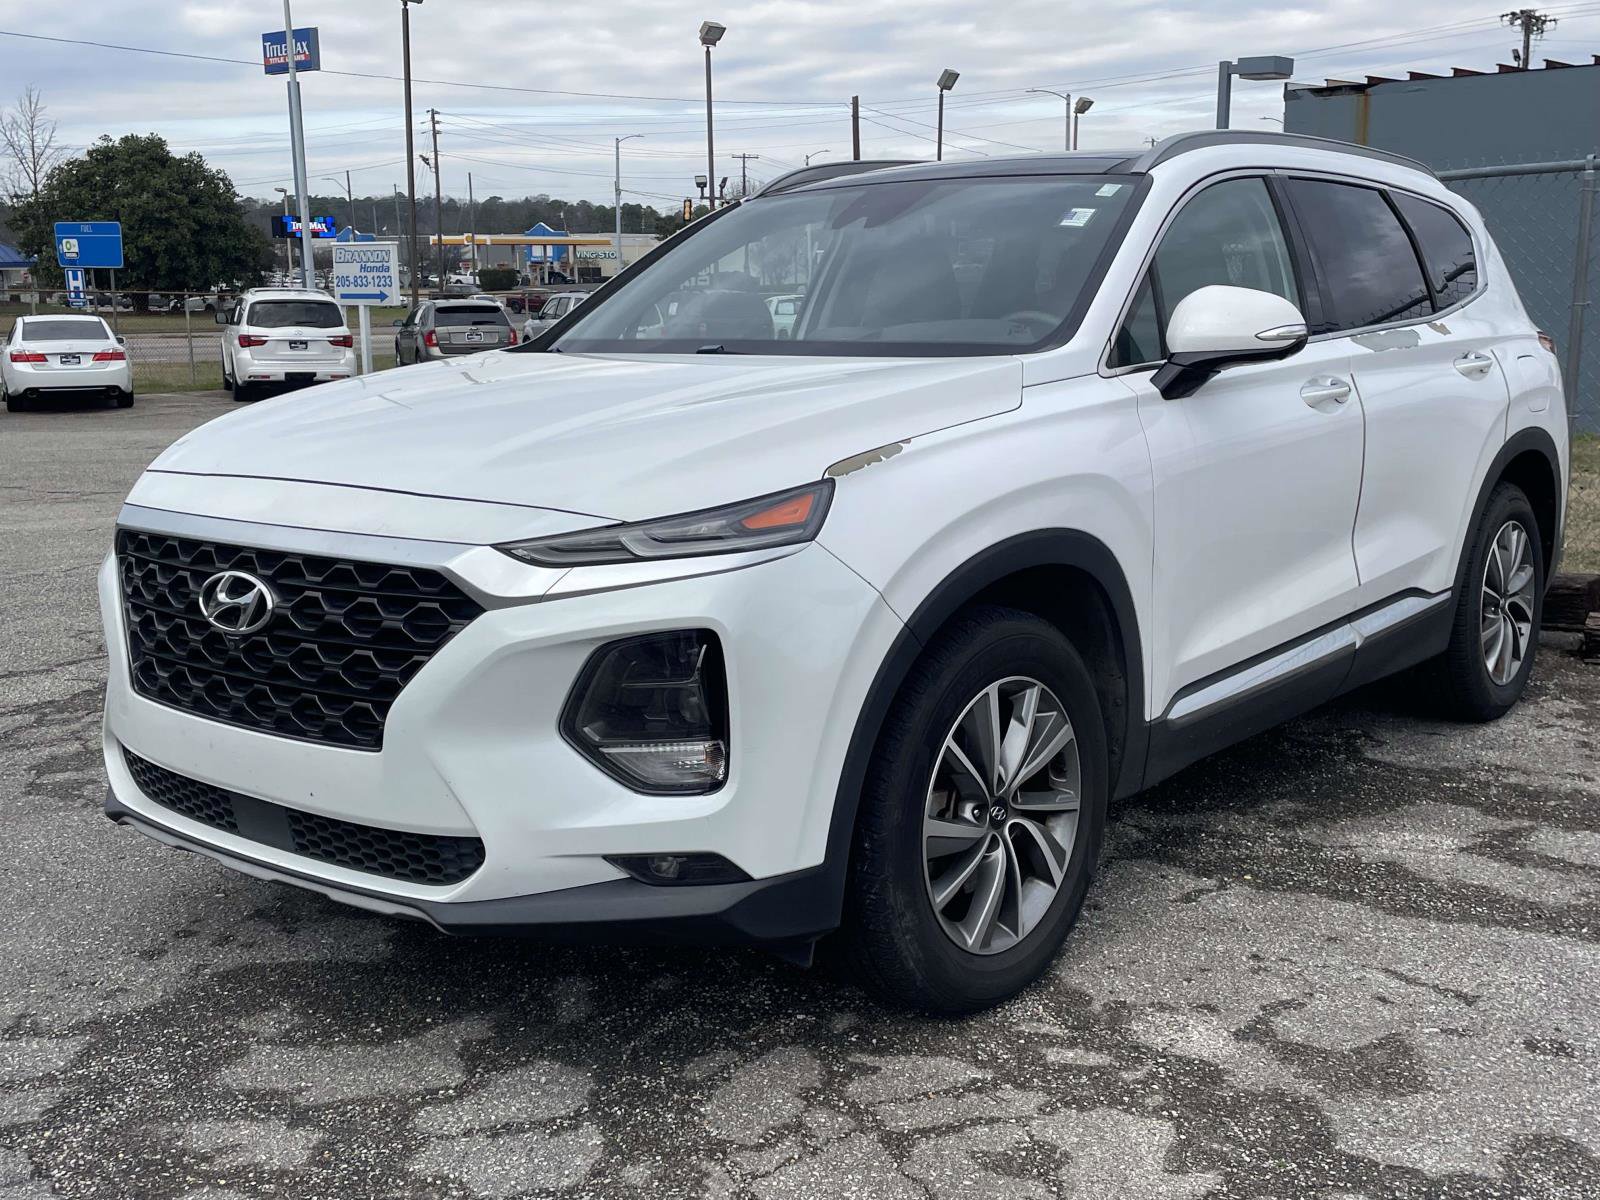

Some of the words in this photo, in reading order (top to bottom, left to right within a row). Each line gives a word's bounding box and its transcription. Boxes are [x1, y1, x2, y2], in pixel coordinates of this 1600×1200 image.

[290, 221, 328, 232] TITMAX
[335, 247, 391, 263] BRANNON
[359, 263, 389, 273] Honda
[335, 275, 393, 288] 205-833-1233
